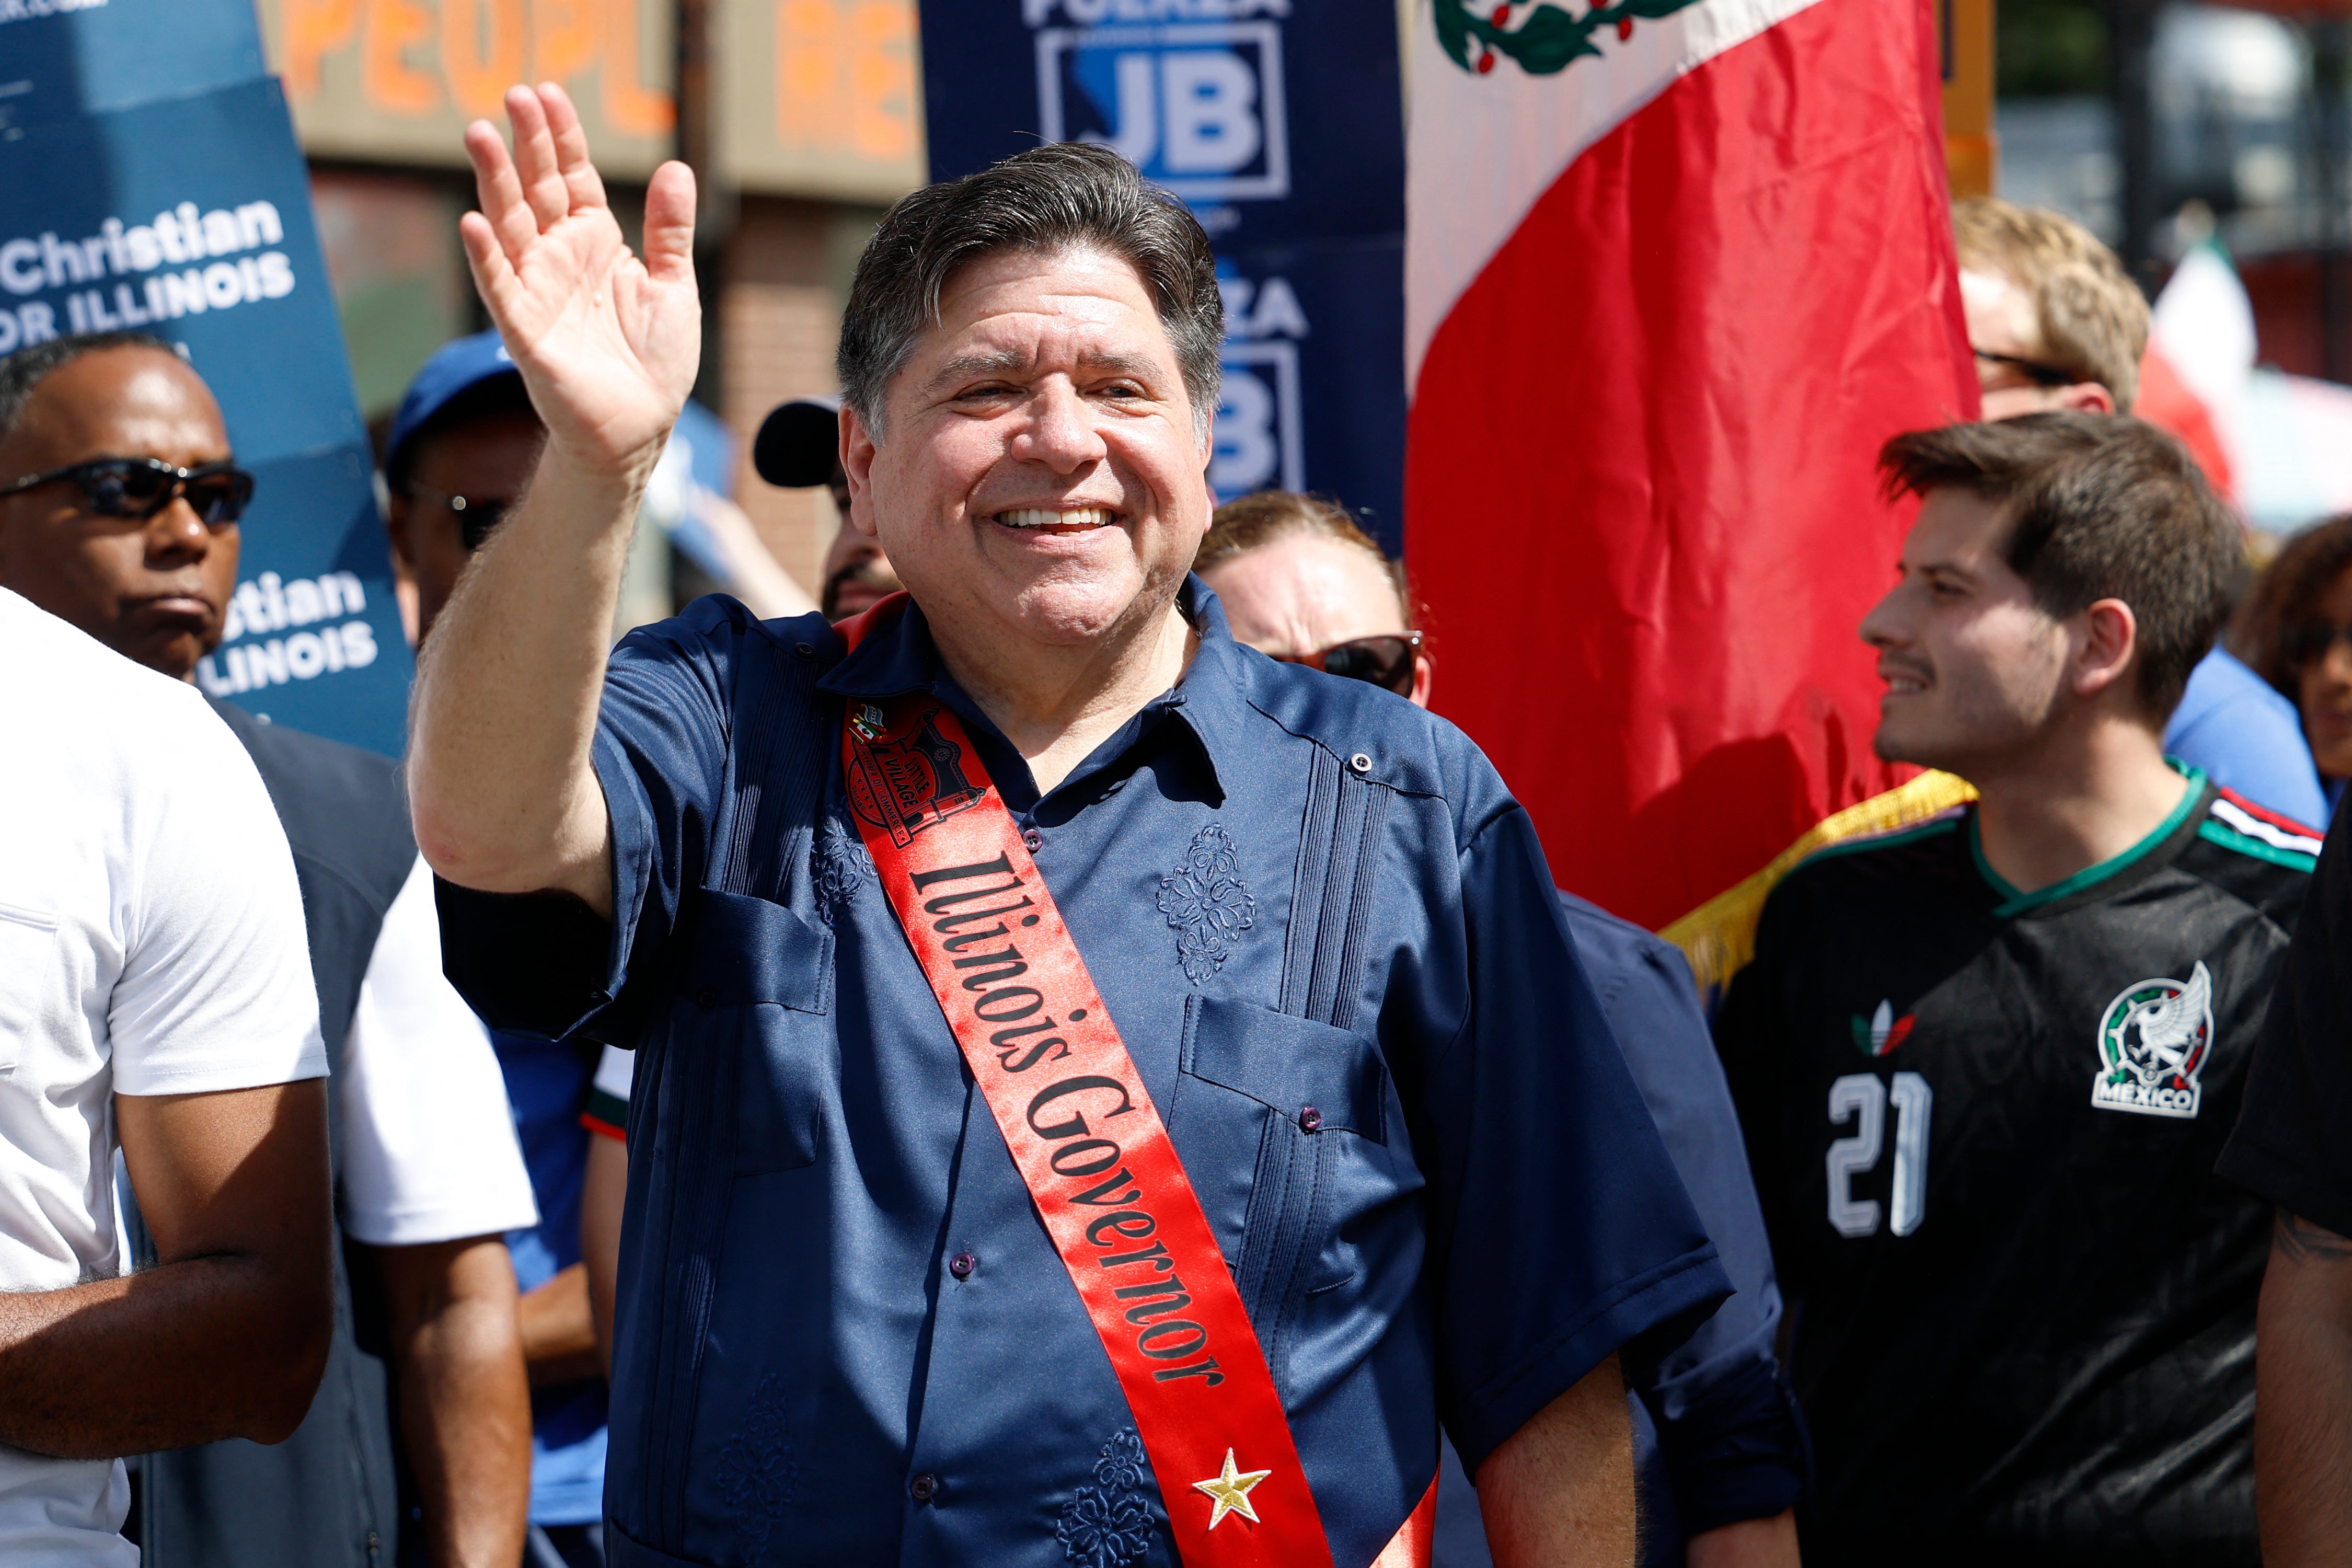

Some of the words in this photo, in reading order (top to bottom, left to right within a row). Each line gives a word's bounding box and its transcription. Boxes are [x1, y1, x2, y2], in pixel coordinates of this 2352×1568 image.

[1076, 49, 1261, 176] JB
[0, 201, 284, 296] Christian
[0, 303, 61, 355] OR
[66, 251, 295, 337] ILLINOIS
[1208, 370, 1278, 490] B
[222, 570, 366, 643] stian
[197, 620, 378, 697] LINOIS
[852, 785, 866, 810] CHICAGO
[858, 745, 877, 777] CHAMBER
[873, 778, 883, 788] OF
[883, 758, 920, 809] VILLAGE
[903, 758, 931, 795] LITTLE
[877, 790, 904, 837] COMMERCE
[908, 850, 1087, 1073] Illinois
[1026, 1075, 1225, 1386] Governor
[1826, 1071, 1933, 1239] 21
